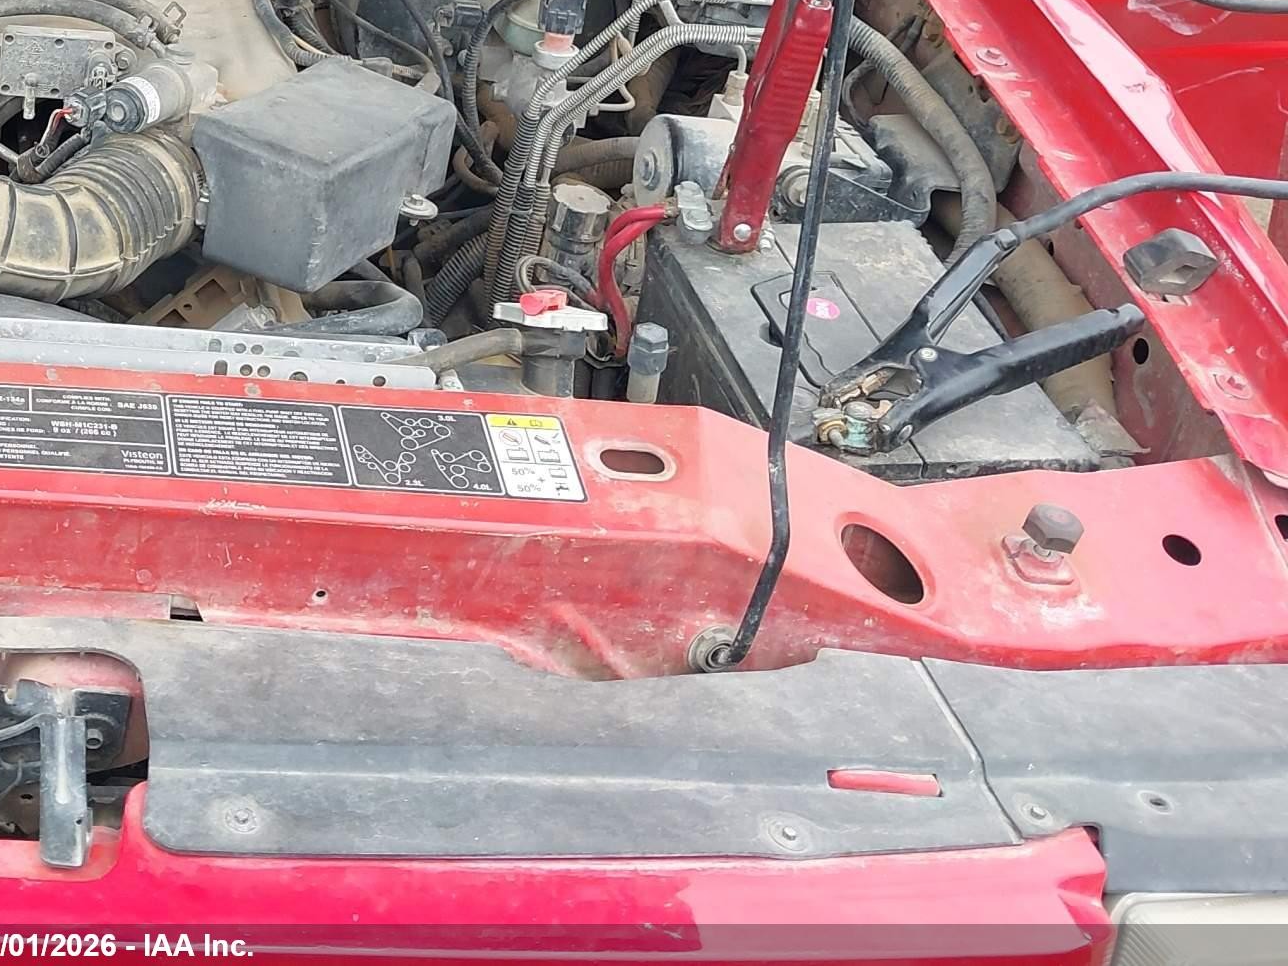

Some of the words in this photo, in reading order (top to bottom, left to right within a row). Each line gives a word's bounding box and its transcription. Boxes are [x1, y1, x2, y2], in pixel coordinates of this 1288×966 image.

[116, 401, 135, 409] SAE
[438, 415, 457, 423] 3.0L
[120, 449, 163, 459] Visteon
[512, 467, 536, 476] 50%
[473, 483, 493, 491] 4.0L
[517, 484, 542, 493] 50%
